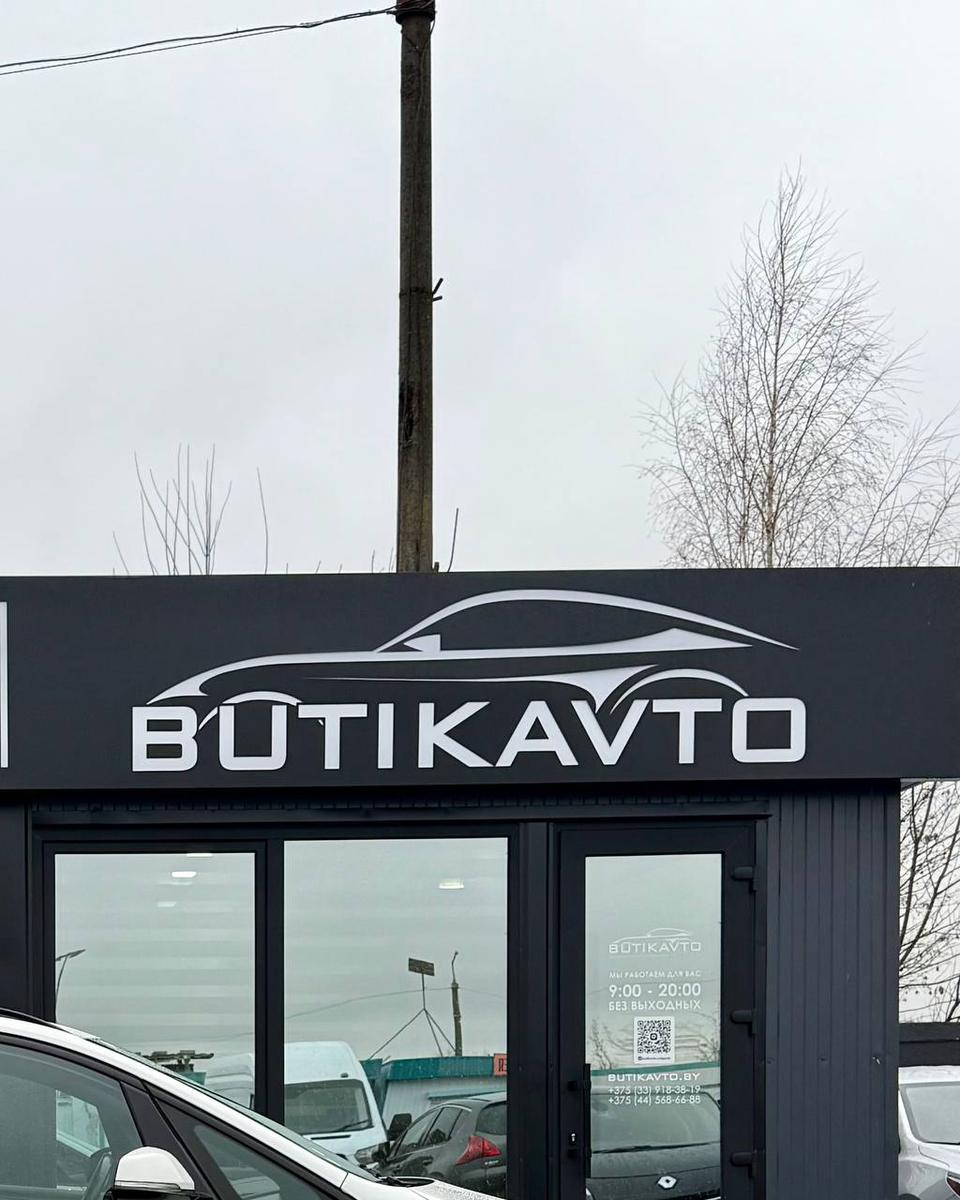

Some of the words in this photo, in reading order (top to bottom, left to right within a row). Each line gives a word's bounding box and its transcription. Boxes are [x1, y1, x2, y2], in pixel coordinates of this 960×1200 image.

[132, 697, 807, 773] BUTIKAVTO
[608, 942, 701, 953] BUTIKAVTO
[609, 984, 642, 998] 9:00
[658, 983, 701, 997] 20:00
[608, 1001, 627, 1011] БЕЗ
[631, 1000, 701, 1011] ВЫХОДНЫХ
[608, 1073, 700, 1082] BUTIKAVTO.BY
[608, 1086, 631, 1095] +375
[634, 1085, 652, 1096] (33)
[654, 1085, 701, 1094] 918-38-19
[608, 1096, 631, 1105] +375
[634, 1095, 652, 1106] (44)
[654, 1095, 701, 1105] 568-66-88
